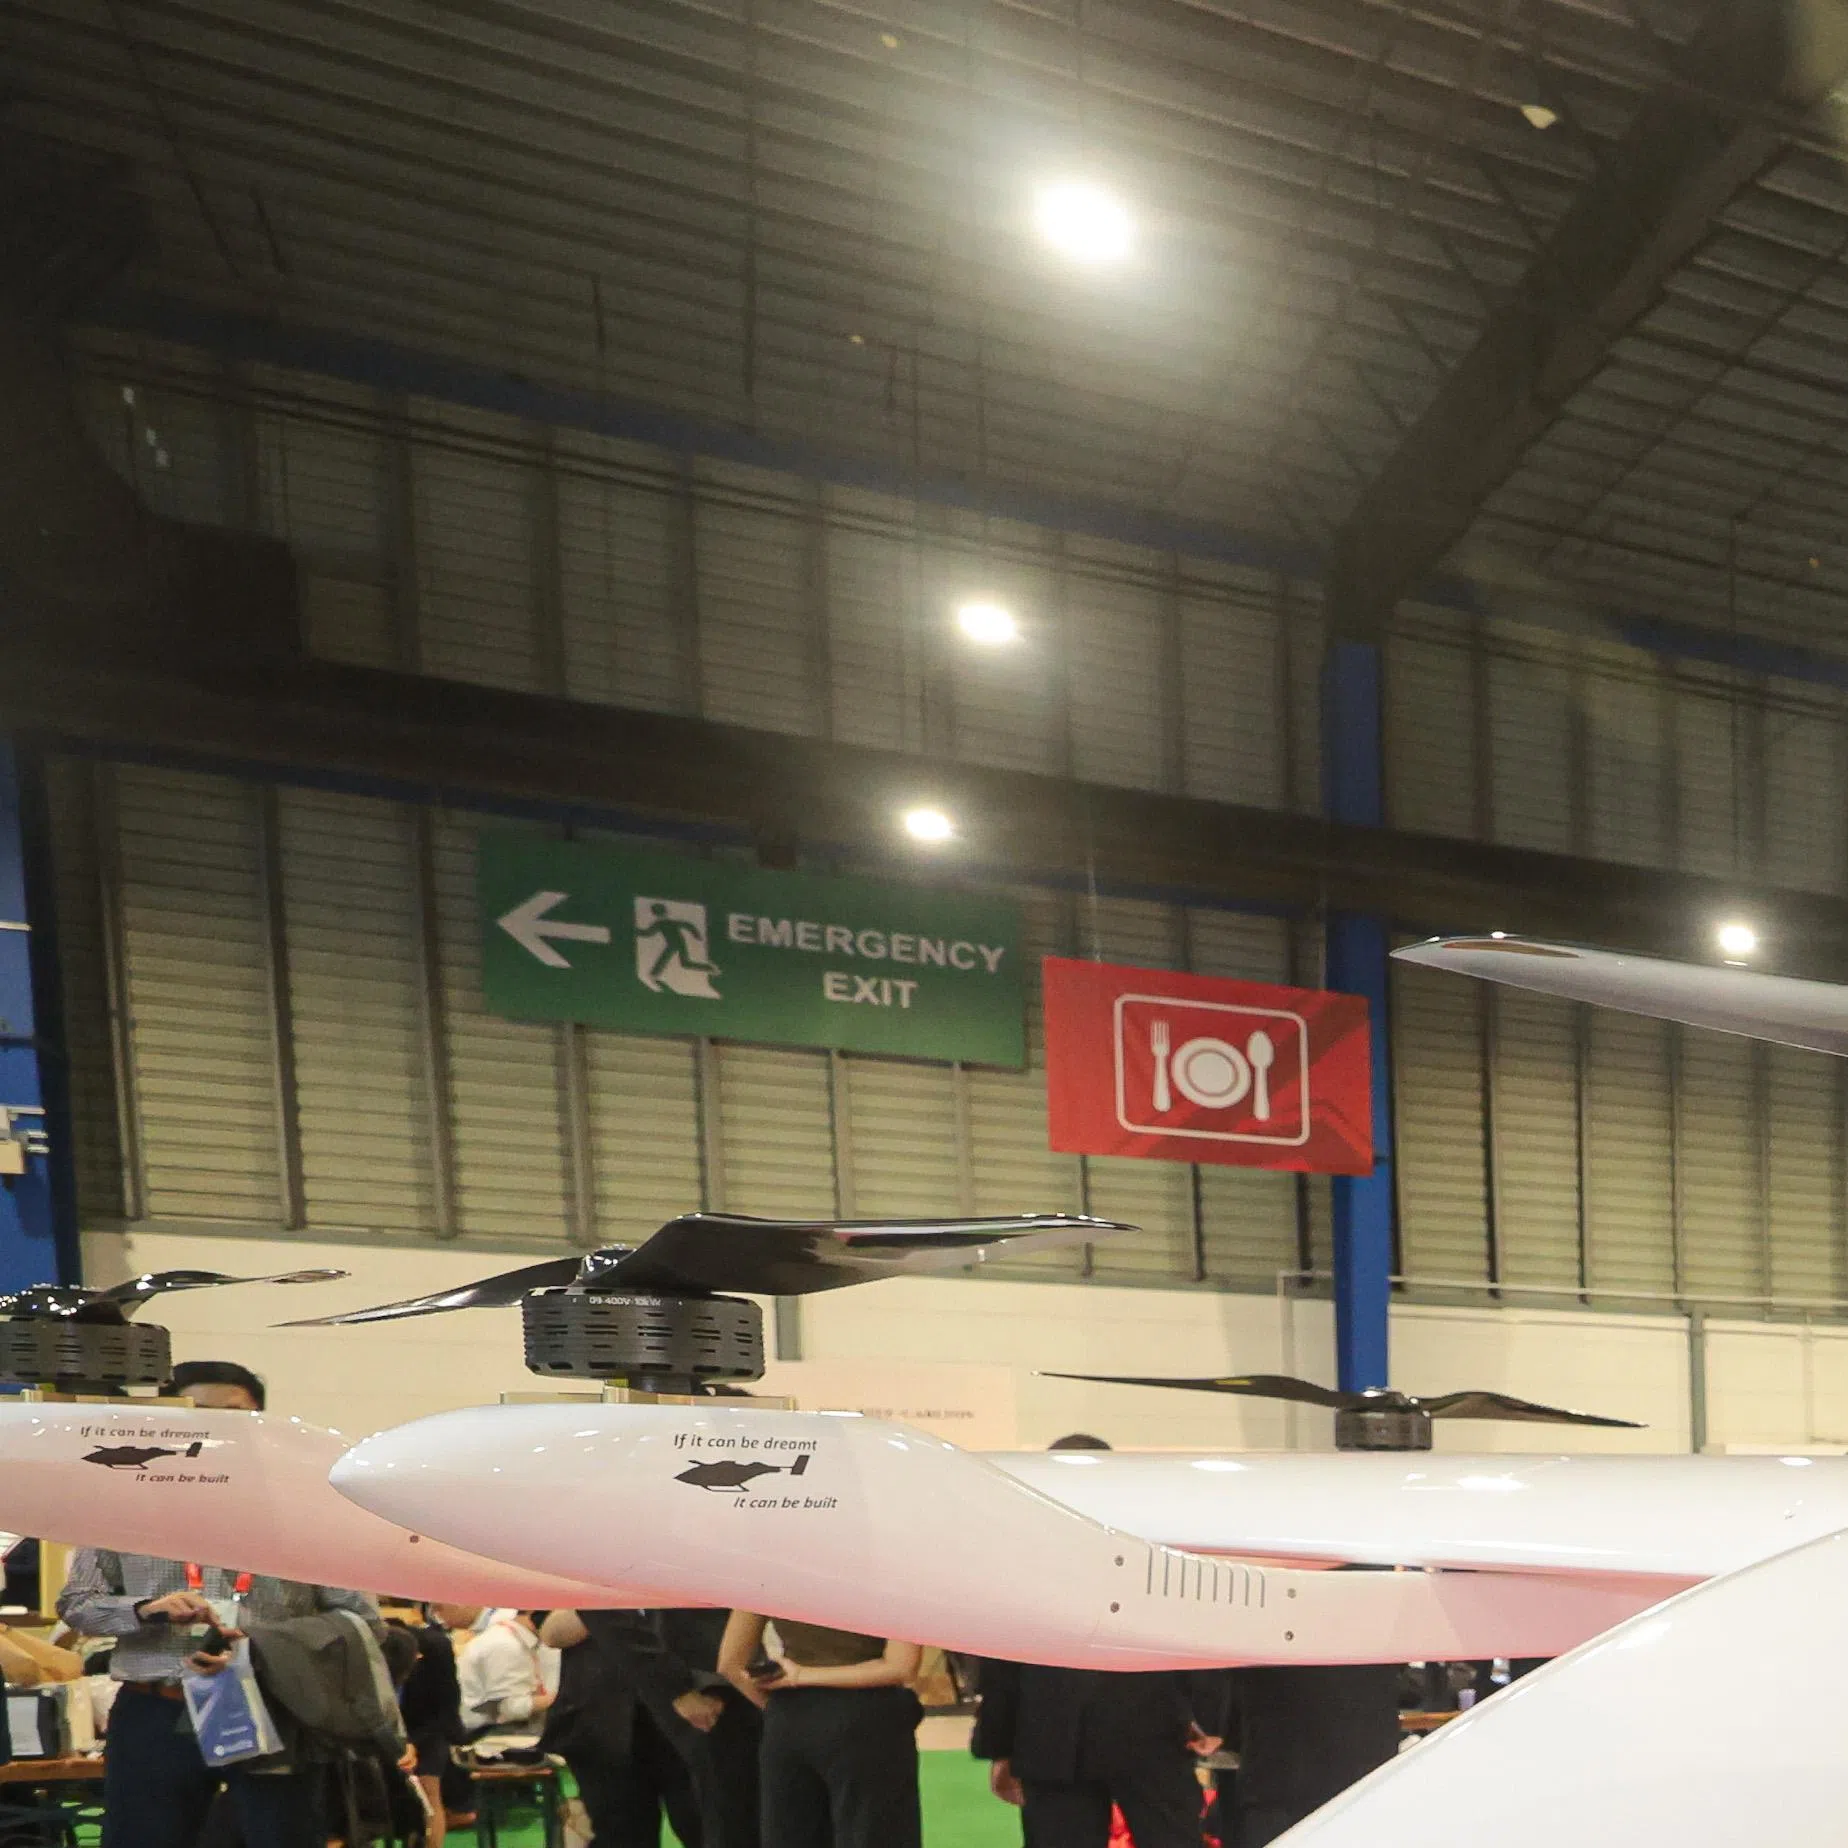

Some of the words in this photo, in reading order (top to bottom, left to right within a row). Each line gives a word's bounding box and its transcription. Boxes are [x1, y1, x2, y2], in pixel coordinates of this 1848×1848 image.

[727, 912, 1004, 974] EMERGENCY
[823, 971, 918, 1009] EXIT
[80, 1425, 93, 1438] If
[95, 1426, 106, 1437] it
[110, 1429, 135, 1437] can
[140, 1428, 156, 1437] be
[160, 1428, 211, 1439] dreamt
[674, 1433, 687, 1449] If
[690, 1433, 703, 1447] it
[707, 1437, 736, 1448] can
[740, 1436, 759, 1449] be
[763, 1437, 818, 1451] dreamt
[149, 1475, 174, 1483] can
[178, 1474, 195, 1483] be
[199, 1474, 230, 1484] built
[749, 1498, 777, 1509] can
[781, 1497, 800, 1509] be
[803, 1497, 838, 1509] built
